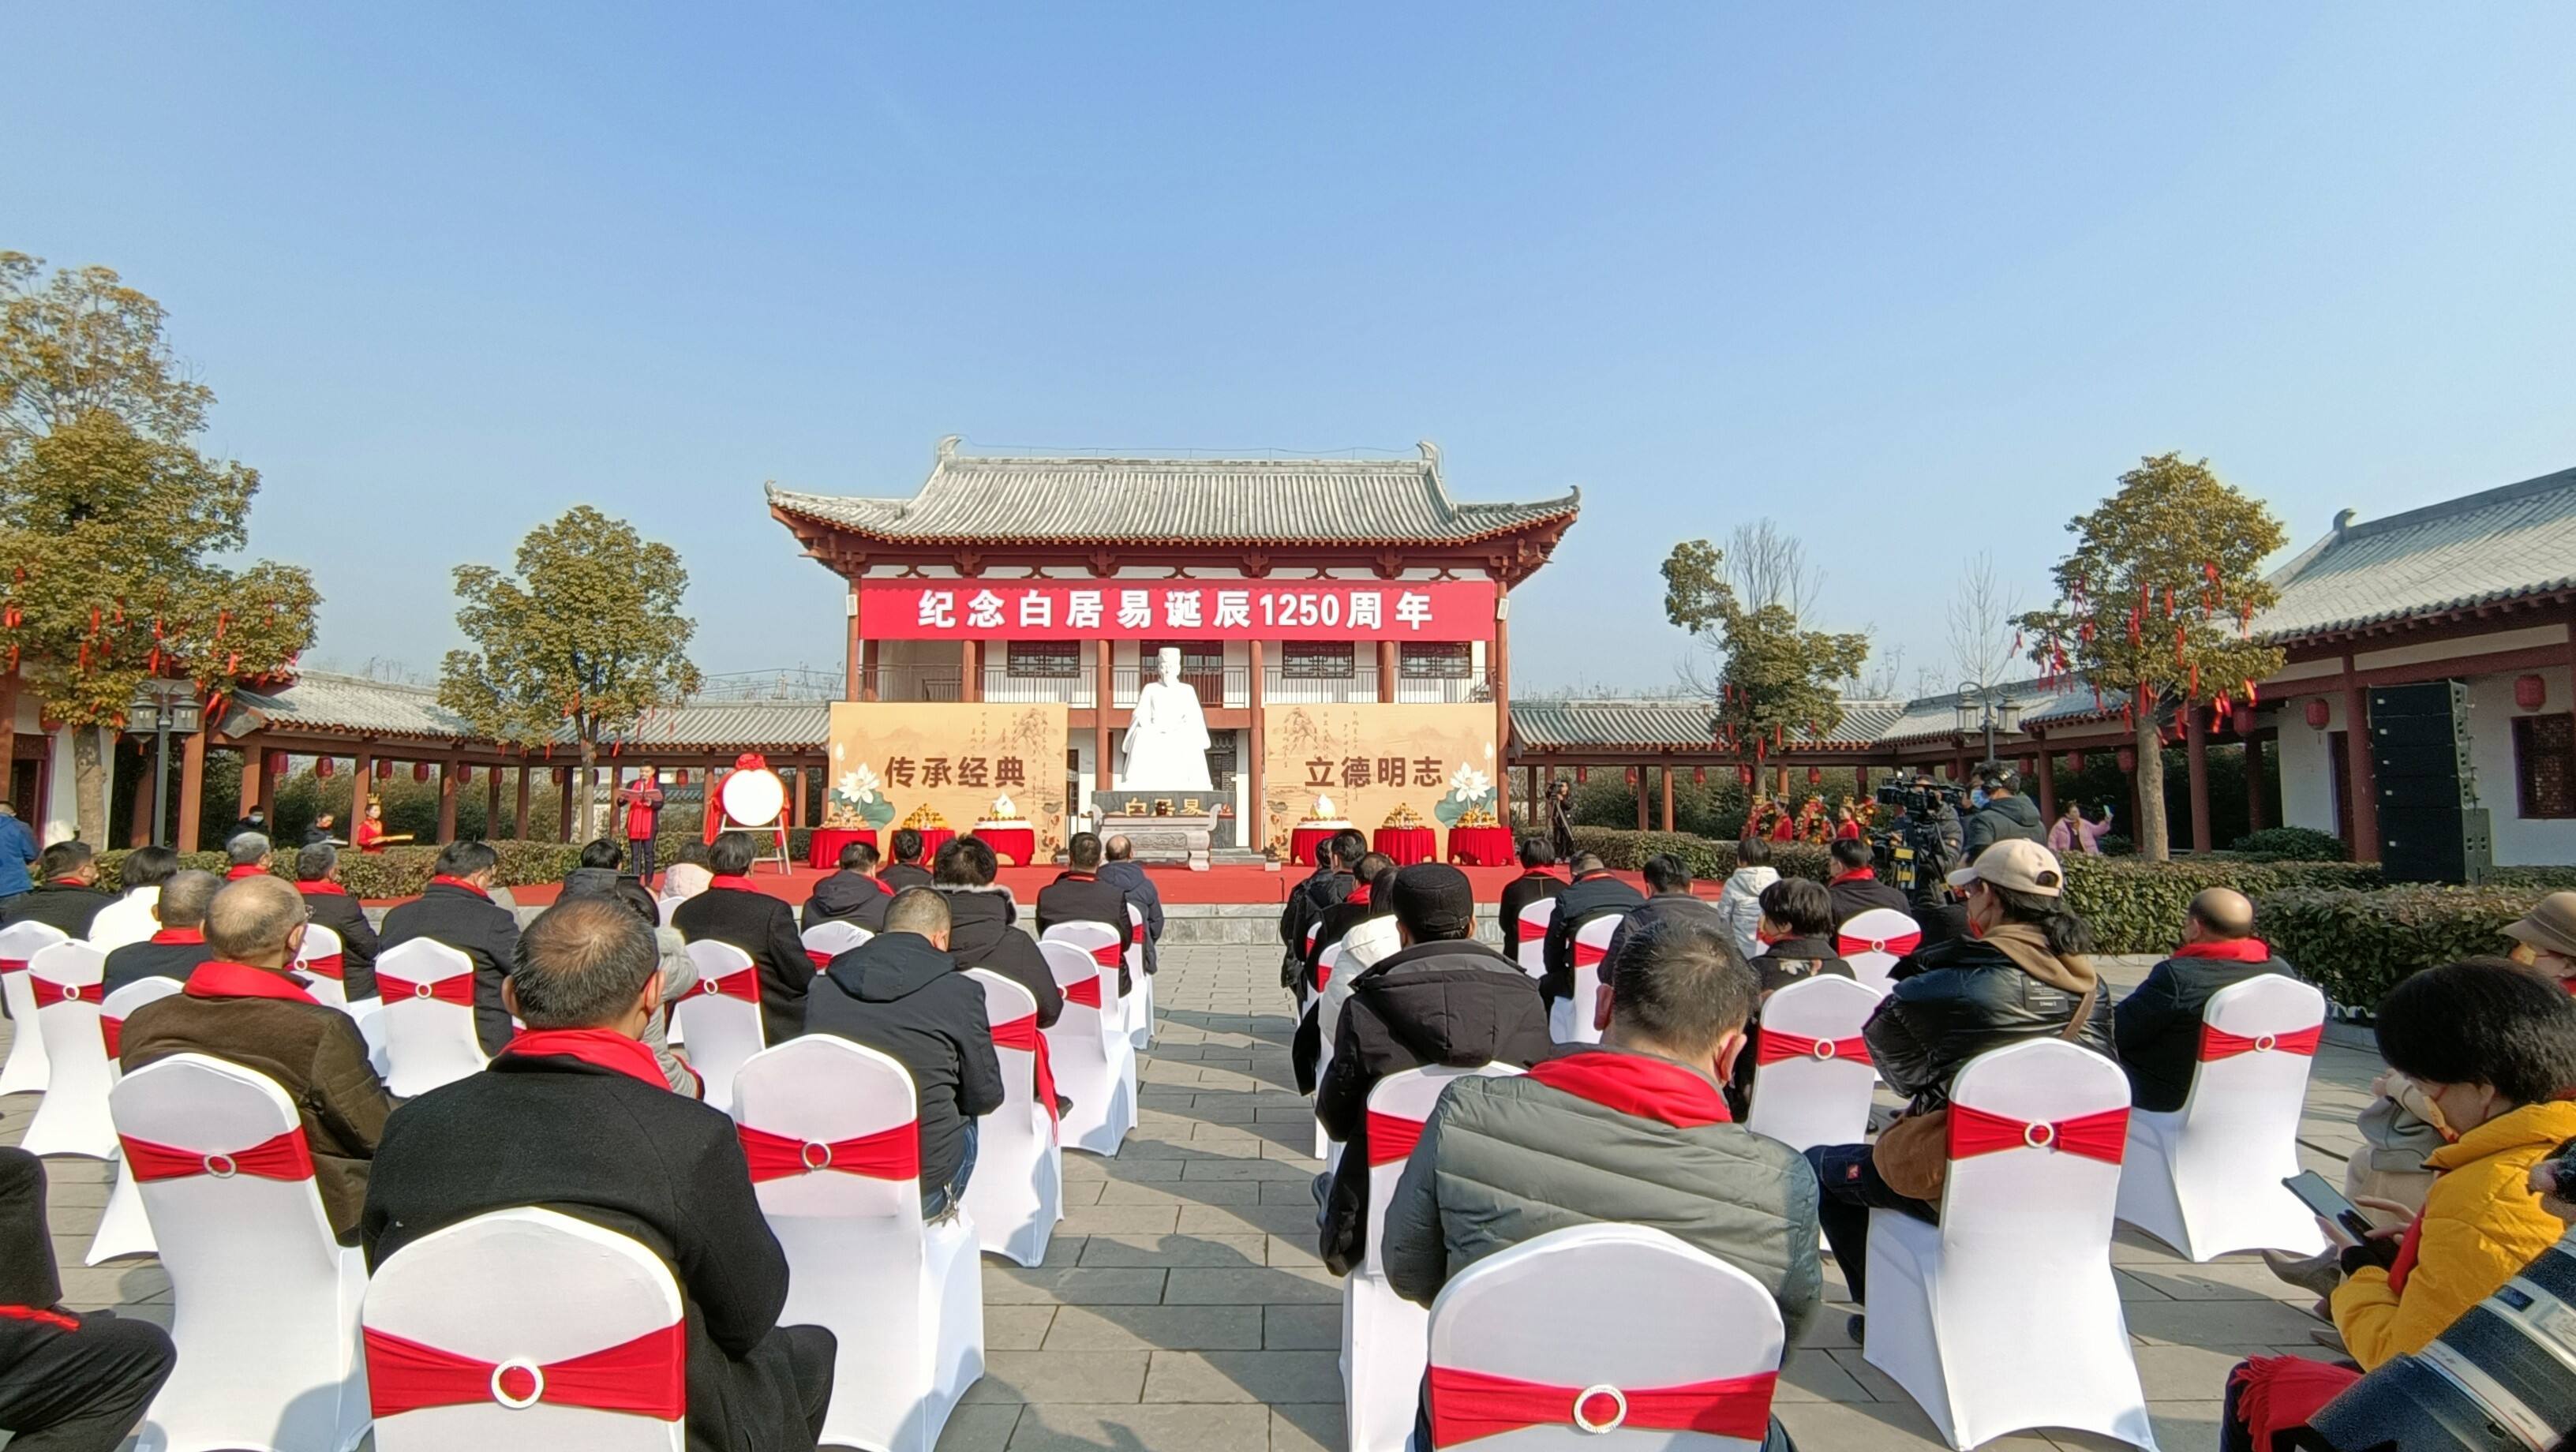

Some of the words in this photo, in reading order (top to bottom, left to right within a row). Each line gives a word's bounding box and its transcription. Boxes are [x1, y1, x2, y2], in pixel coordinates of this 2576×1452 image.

[918, 589, 1432, 631] 纪念白居易诞辰1250周年
[885, 756, 1025, 788] 传承经典
[1305, 756, 1443, 788] 立德明志
